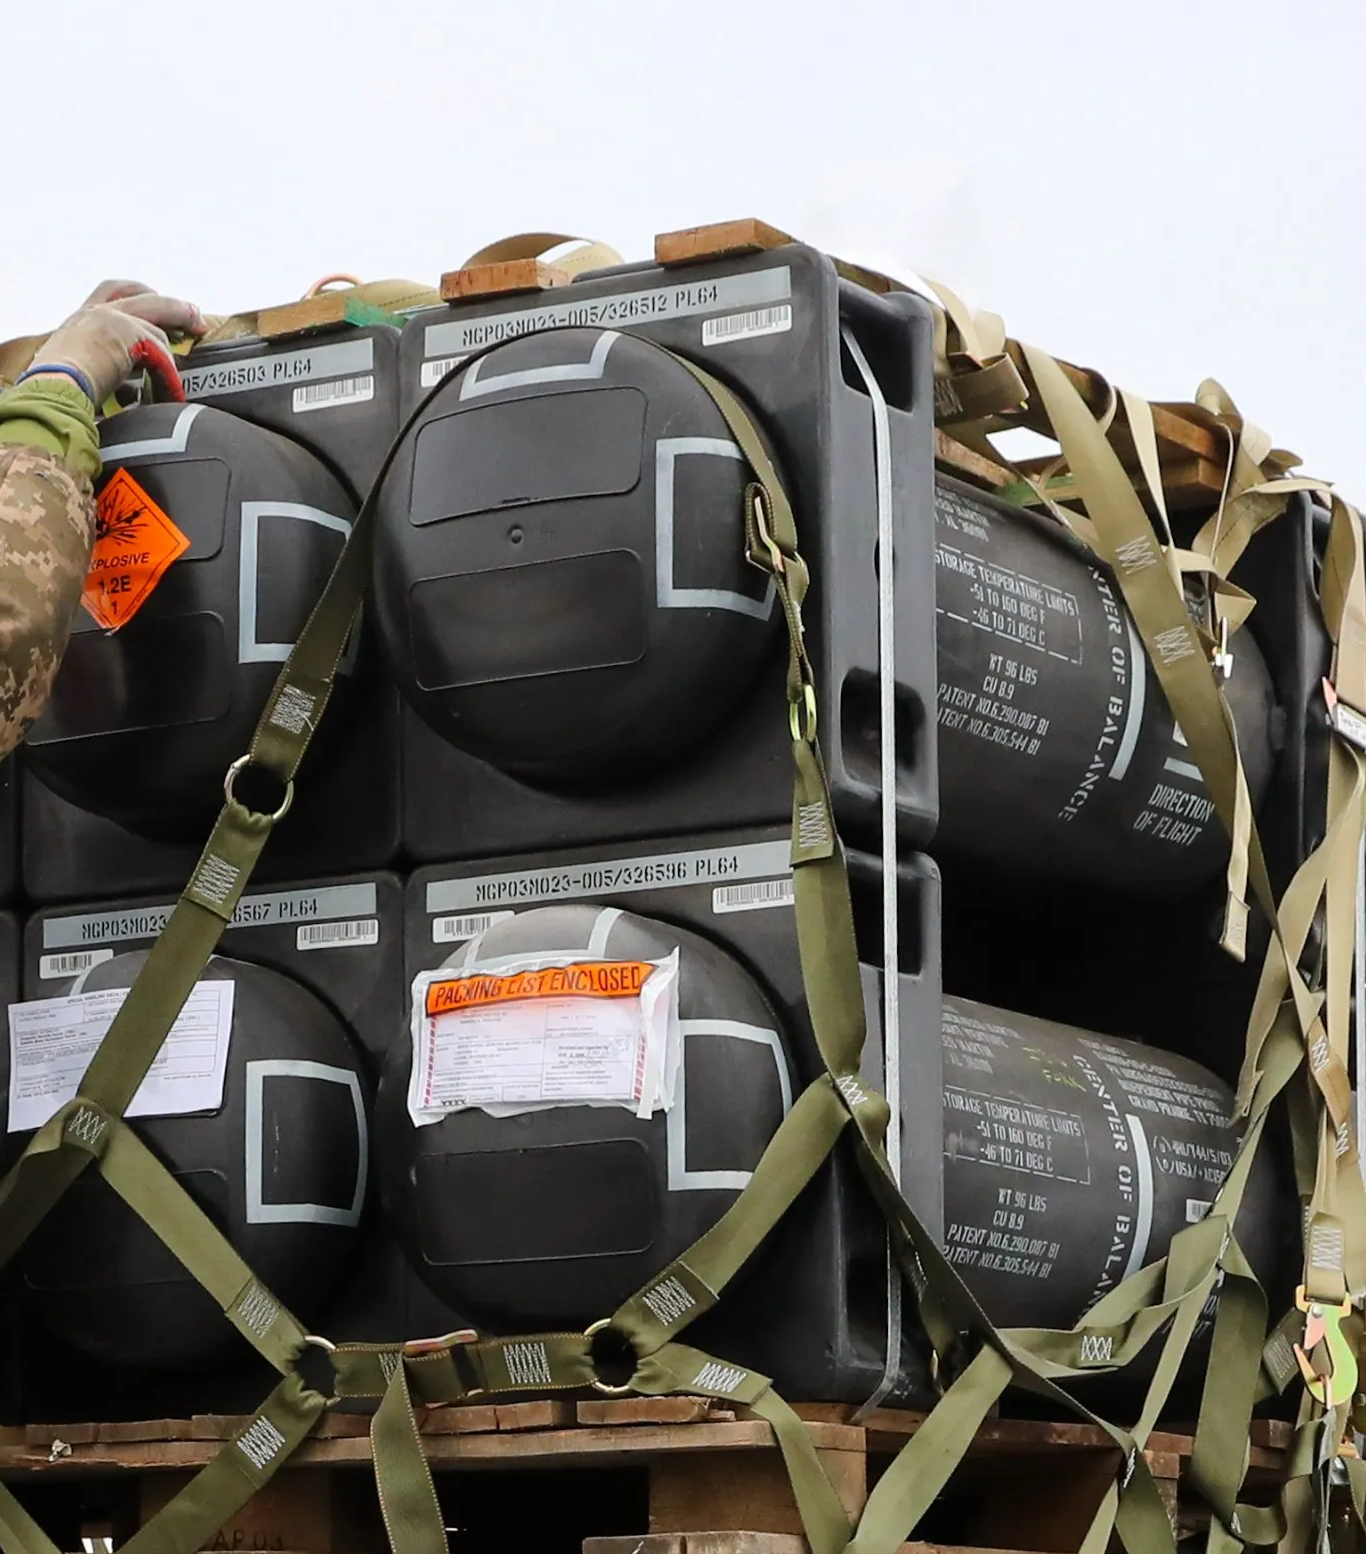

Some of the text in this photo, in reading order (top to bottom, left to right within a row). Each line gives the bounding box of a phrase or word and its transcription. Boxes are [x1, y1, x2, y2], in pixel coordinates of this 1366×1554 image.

[675, 285, 718, 309] PL64
[273, 358, 312, 379] PL64
[91, 551, 150, 571] XPLOSIVE
[98, 575, 132, 594] 1.2E
[978, 565, 1044, 605] TEMPERATURE
[1044, 591, 1075, 616] LIMITS
[986, 588, 999, 606] TO
[1020, 601, 1038, 621] DEG
[992, 611, 1004, 630] TO
[1019, 623, 1037, 642] DEG
[1005, 659, 1017, 679] 96
[1019, 663, 1038, 686] LBS
[1111, 647, 1125, 686] OF
[935, 682, 976, 710] PATENT
[982, 675, 998, 695] CU
[1057, 696, 1124, 822] BALANCE
[1148, 783, 1216, 824] DIRECTION
[1133, 810, 1203, 847] OF FLIGHT
[695, 855, 738, 877] PL64
[279, 898, 317, 918] PL64
[435, 966, 639, 1008] PACKING LIST ENCLOSED
[984, 1101, 1050, 1131] TEMPERATURE
[1050, 1114, 1081, 1137] LIMITS
[1073, 1054, 1128, 1152] CENTER
[1118, 1165, 1132, 1202] OF
[993, 1122, 1005, 1141] TO
[1008, 1127, 1024, 1145] 160
[1026, 1131, 1045, 1149] DEG
[999, 1146, 1012, 1163] TO
[1026, 1152, 1044, 1171] DEG
[1014, 1192, 1026, 1208] 96
[1028, 1195, 1047, 1213] LBS
[993, 1210, 1007, 1227] CU
[947, 1223, 987, 1246] PATENT
